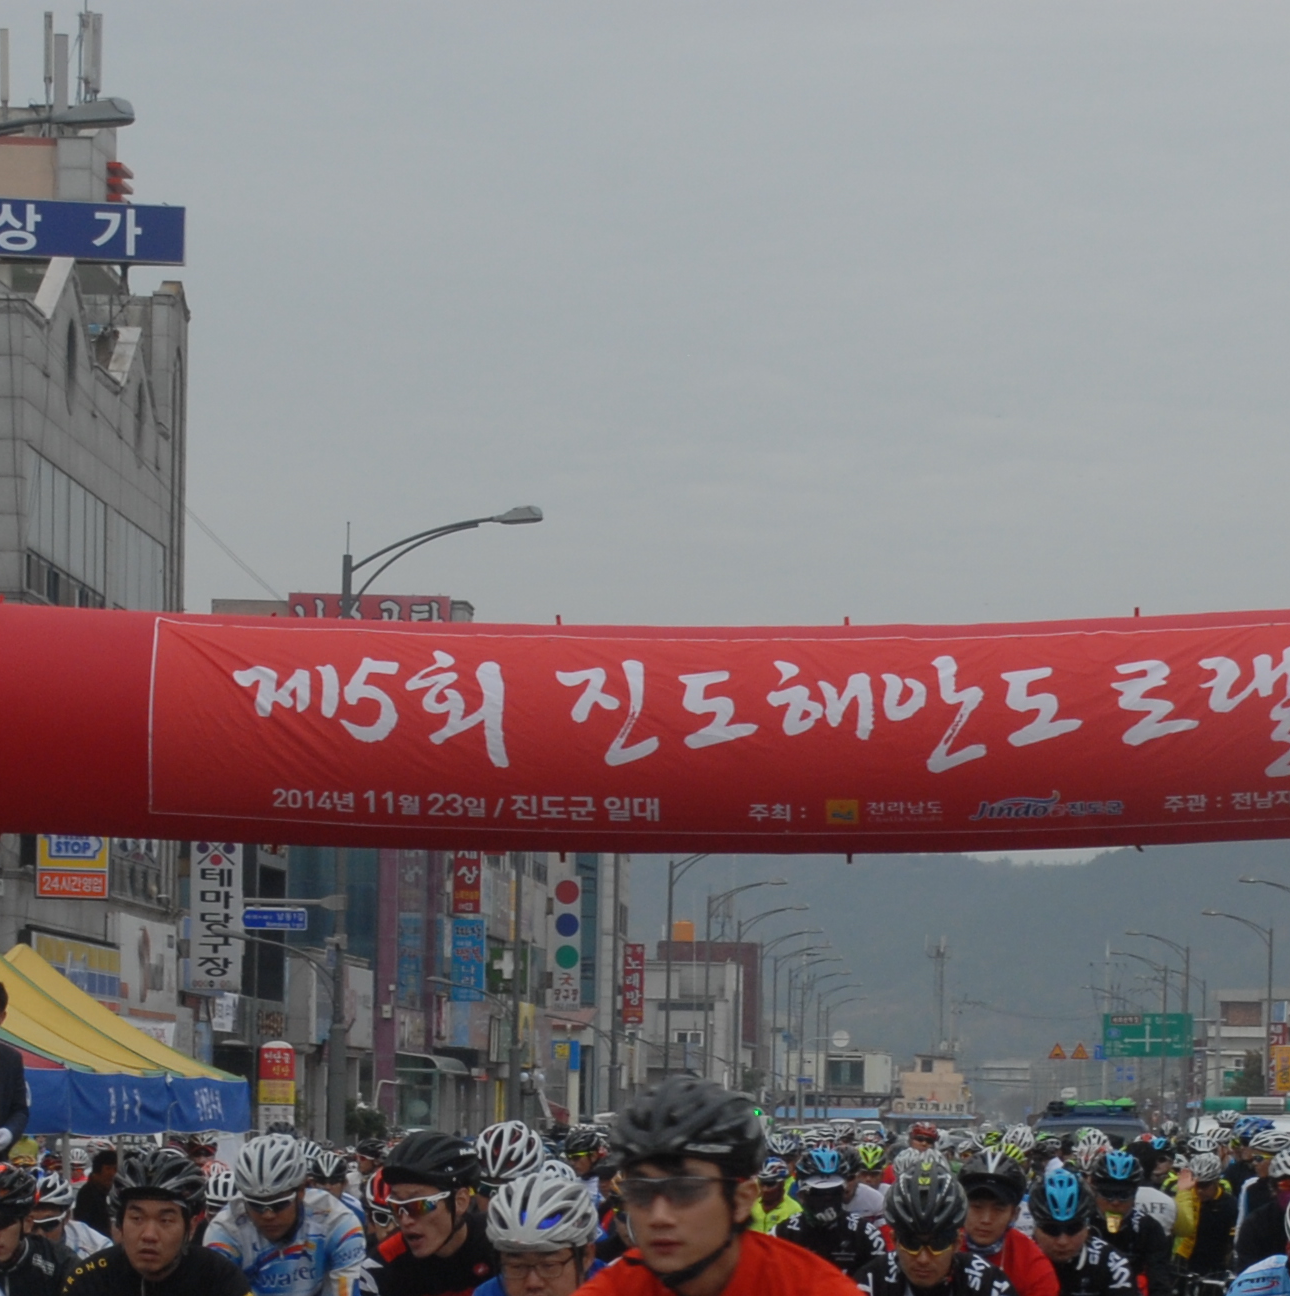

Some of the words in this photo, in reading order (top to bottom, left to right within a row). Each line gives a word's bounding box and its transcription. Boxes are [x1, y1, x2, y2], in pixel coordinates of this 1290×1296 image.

[233, 650, 509, 768] 제5회
[272, 787, 355, 813] 2014년
[362, 789, 420, 816] 11월
[427, 792, 487, 819] 23일
[510, 795, 596, 821] 진도군
[603, 796, 661, 822] 일대
[865, 800, 944, 816] 전라남도
[55, 841, 92, 855] STOP
[42, 875, 103, 893] 24시간영업
